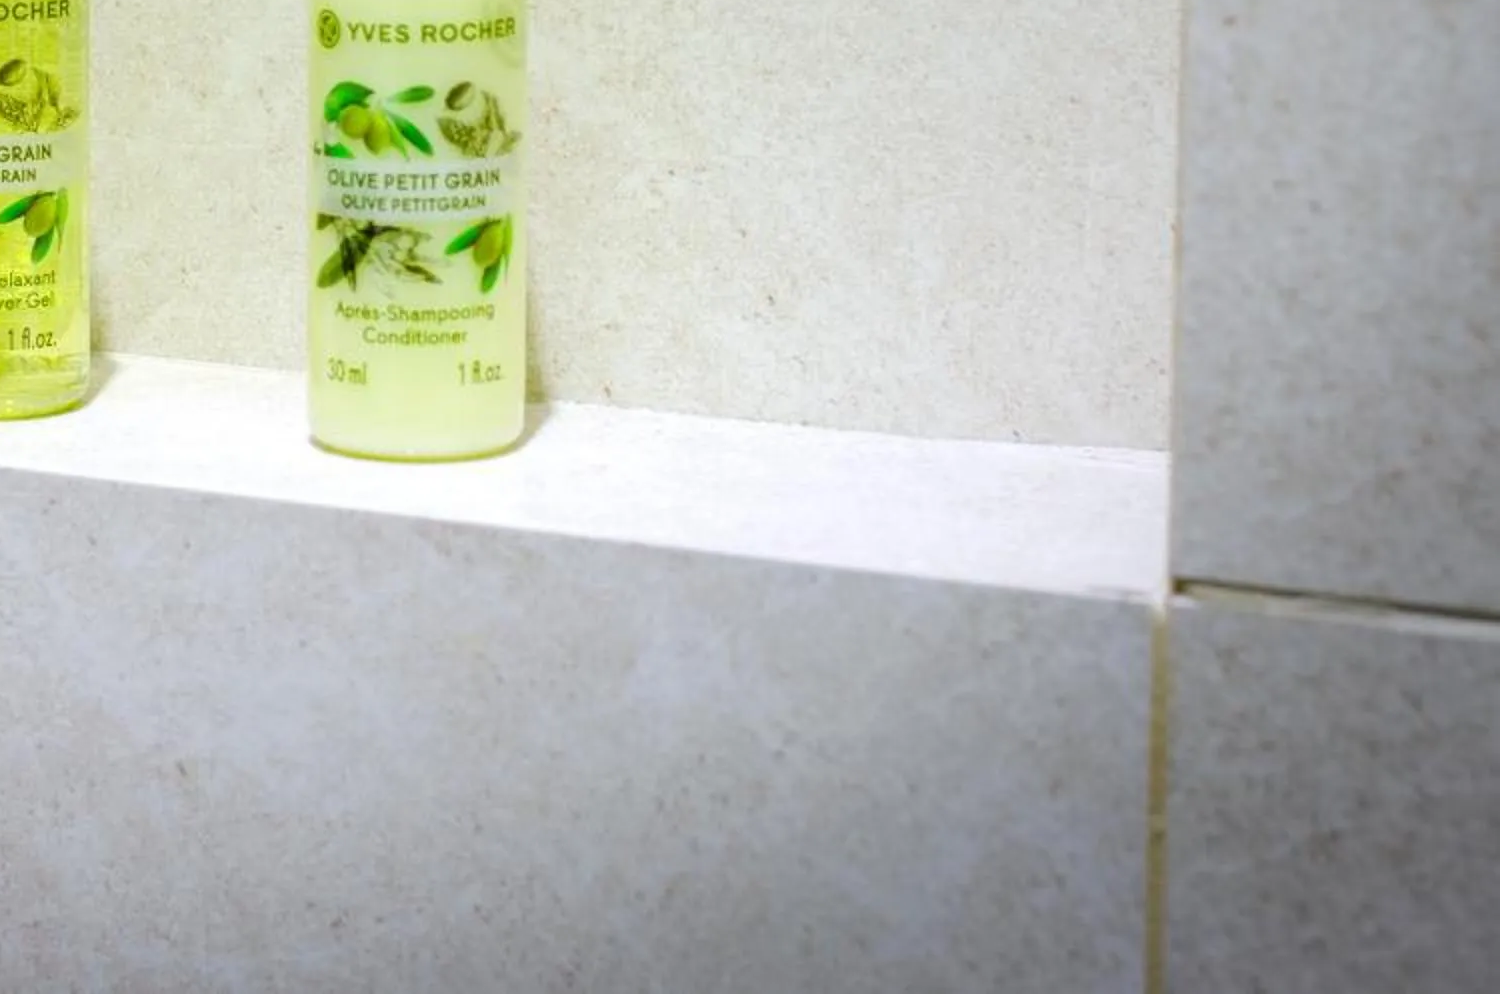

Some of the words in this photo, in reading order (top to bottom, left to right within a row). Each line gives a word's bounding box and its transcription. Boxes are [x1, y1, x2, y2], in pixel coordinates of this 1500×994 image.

[348, 22, 410, 43] YVES
[420, 16, 516, 43] ROCHER
[327, 169, 377, 189] OLIVE
[384, 173, 438, 191] PETIT
[444, 169, 500, 190] GRAIN
[341, 194, 388, 211] OLIVE
[391, 195, 486, 213] PETITGRAIN
[26, 291, 55, 309] Gel
[335, 302, 496, 323] Après-Shampooing
[8, 329, 15, 350] 1
[362, 326, 469, 346] Conditioner
[327, 358, 345, 382] 30
[350, 362, 367, 385] ml
[458, 363, 465, 385] 1
